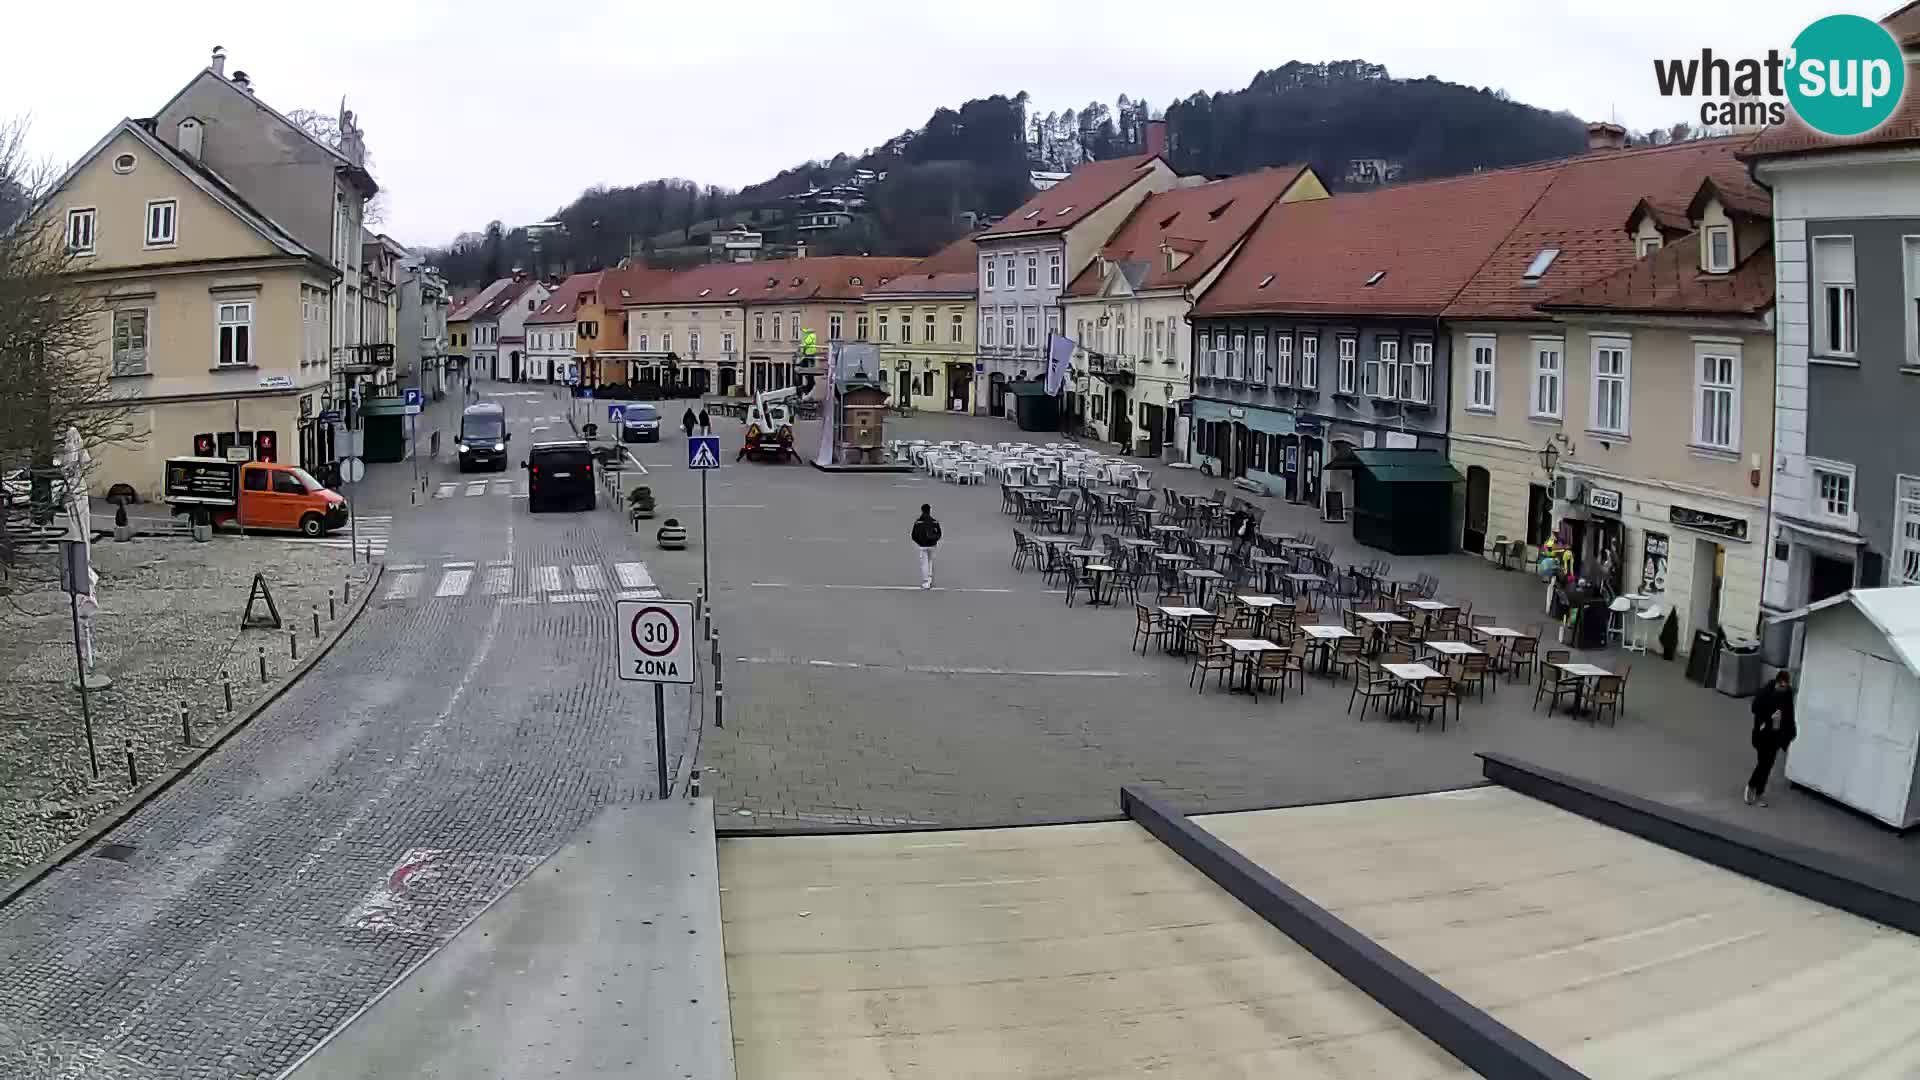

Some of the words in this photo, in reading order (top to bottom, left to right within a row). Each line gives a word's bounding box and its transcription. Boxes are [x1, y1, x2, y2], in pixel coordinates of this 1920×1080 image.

[408, 391, 417, 402] P
[644, 622, 668, 644] 30
[634, 659, 679, 677] ZONA
